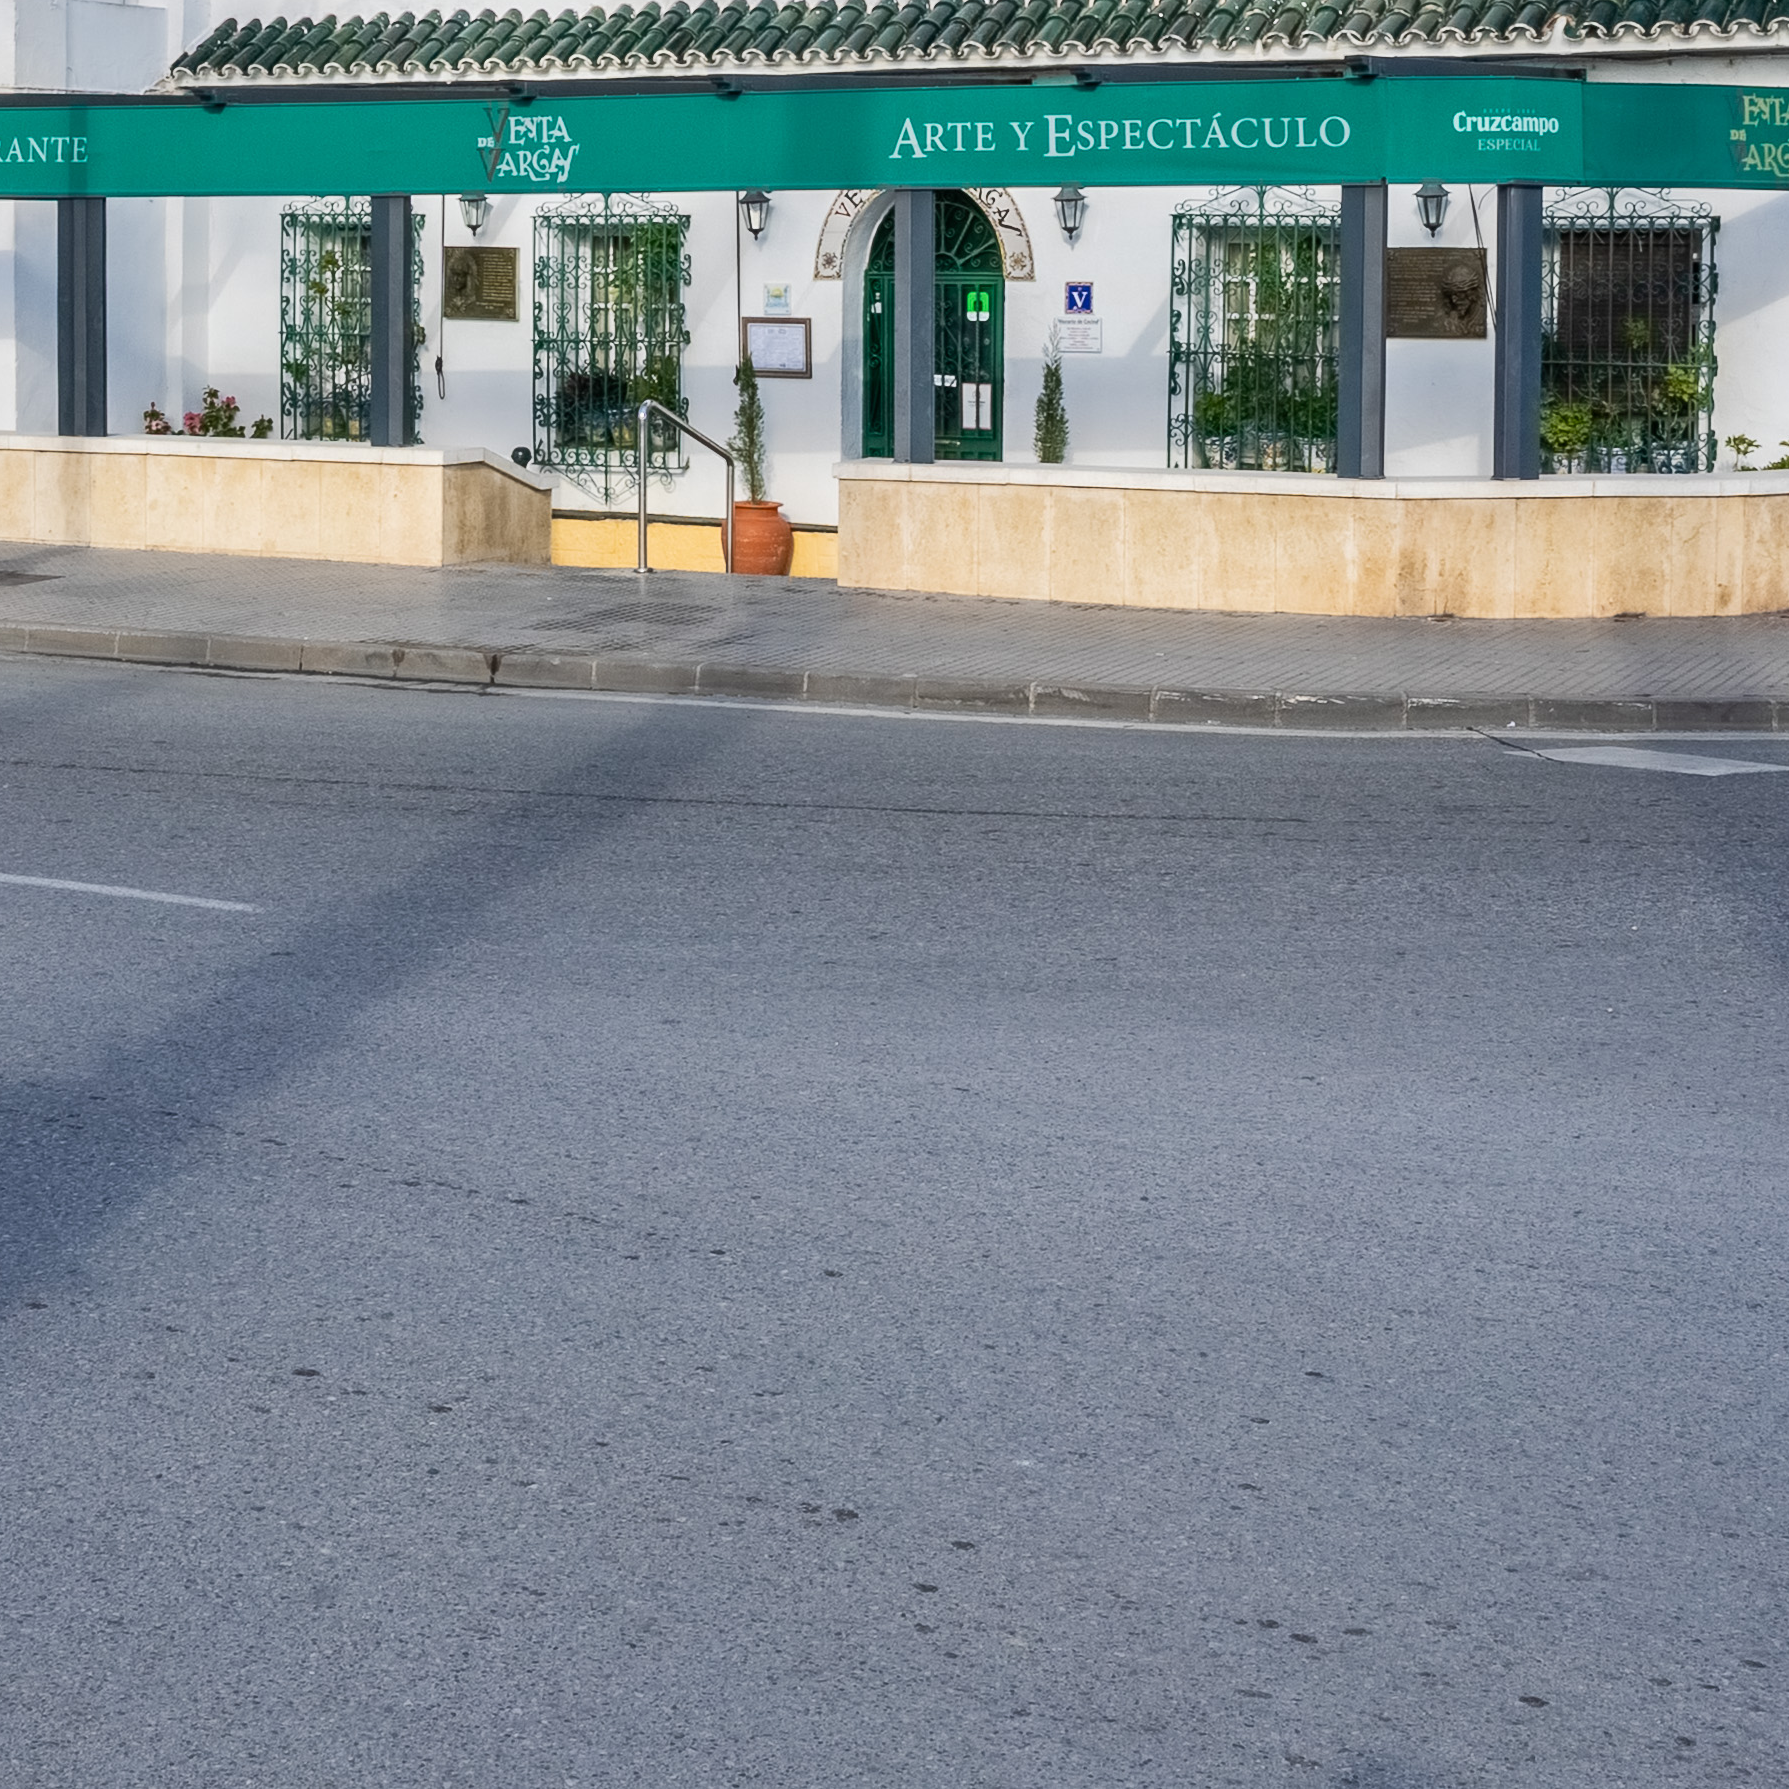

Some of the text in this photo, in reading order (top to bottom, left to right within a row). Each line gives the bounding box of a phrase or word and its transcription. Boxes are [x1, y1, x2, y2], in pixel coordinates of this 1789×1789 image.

[483, 107, 573, 146] VENTA
[1453, 110, 1560, 136] Cruzcampo
[477, 137, 495, 148] DE
[1009, 121, 1034, 151] Y
[1477, 138, 1541, 152] ESPECIAL
[1729, 129, 1747, 142] DE
[477, 143, 580, 183] VARGAS
[1071, 291, 1089, 308] V
